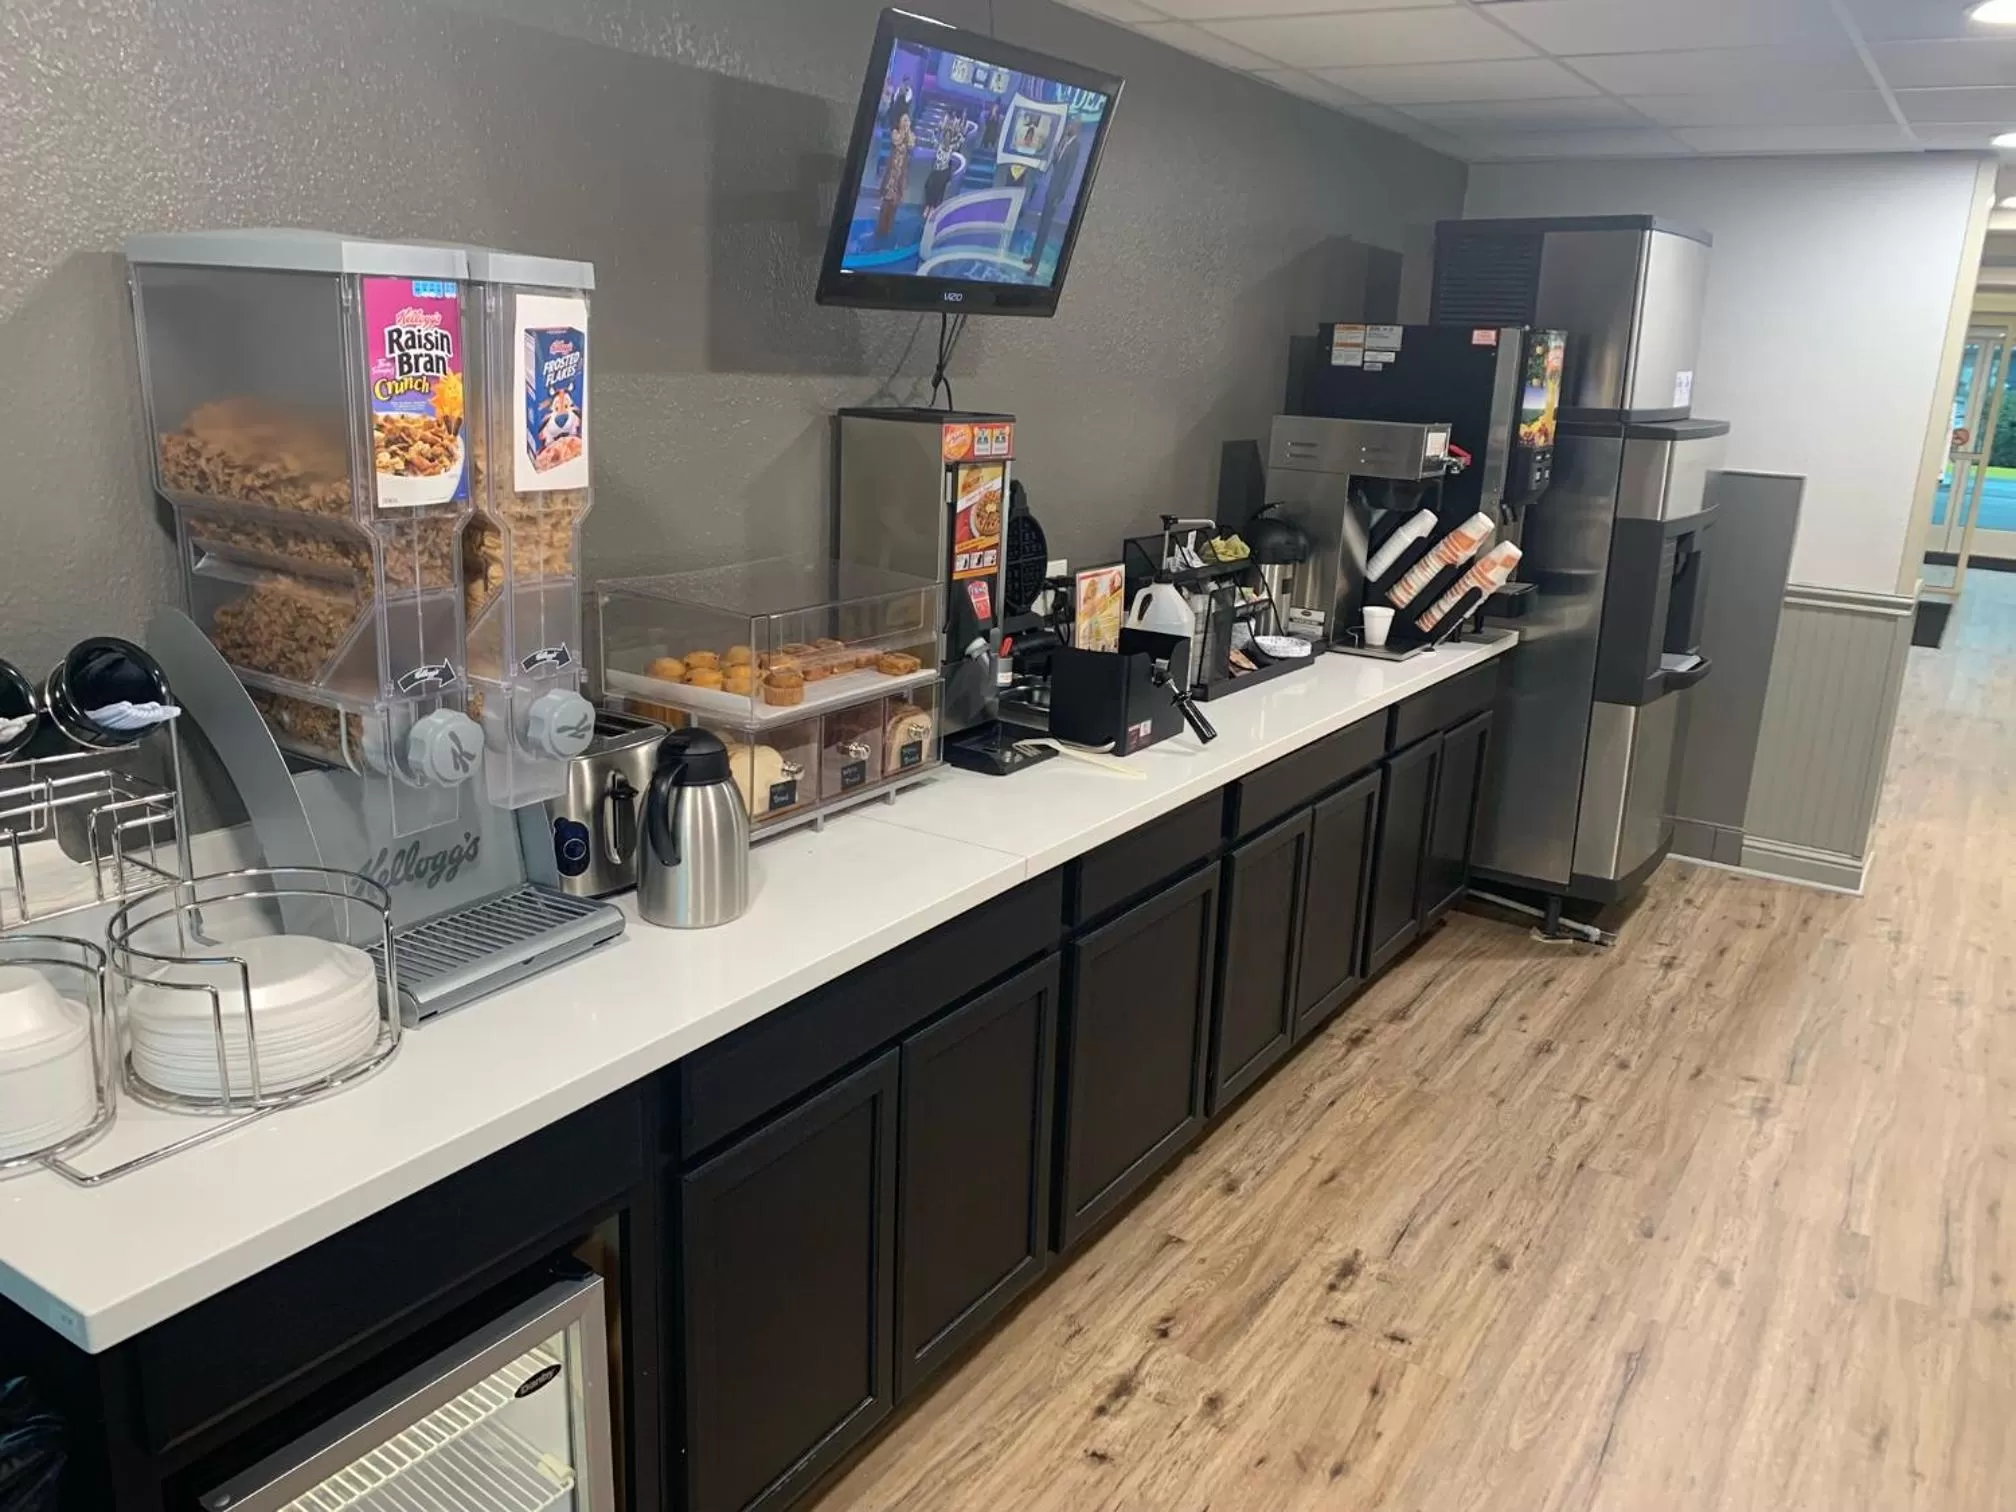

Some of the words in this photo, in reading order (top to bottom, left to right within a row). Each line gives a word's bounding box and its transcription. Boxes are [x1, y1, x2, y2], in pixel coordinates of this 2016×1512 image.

[387, 327, 452, 355] Raisin
[397, 352, 447, 377] Bran
[543, 351, 580, 376] FROSTED
[546, 364, 576, 387] FLAKES
[374, 375, 430, 401] Crunch
[350, 831, 481, 899] Kellogg's
